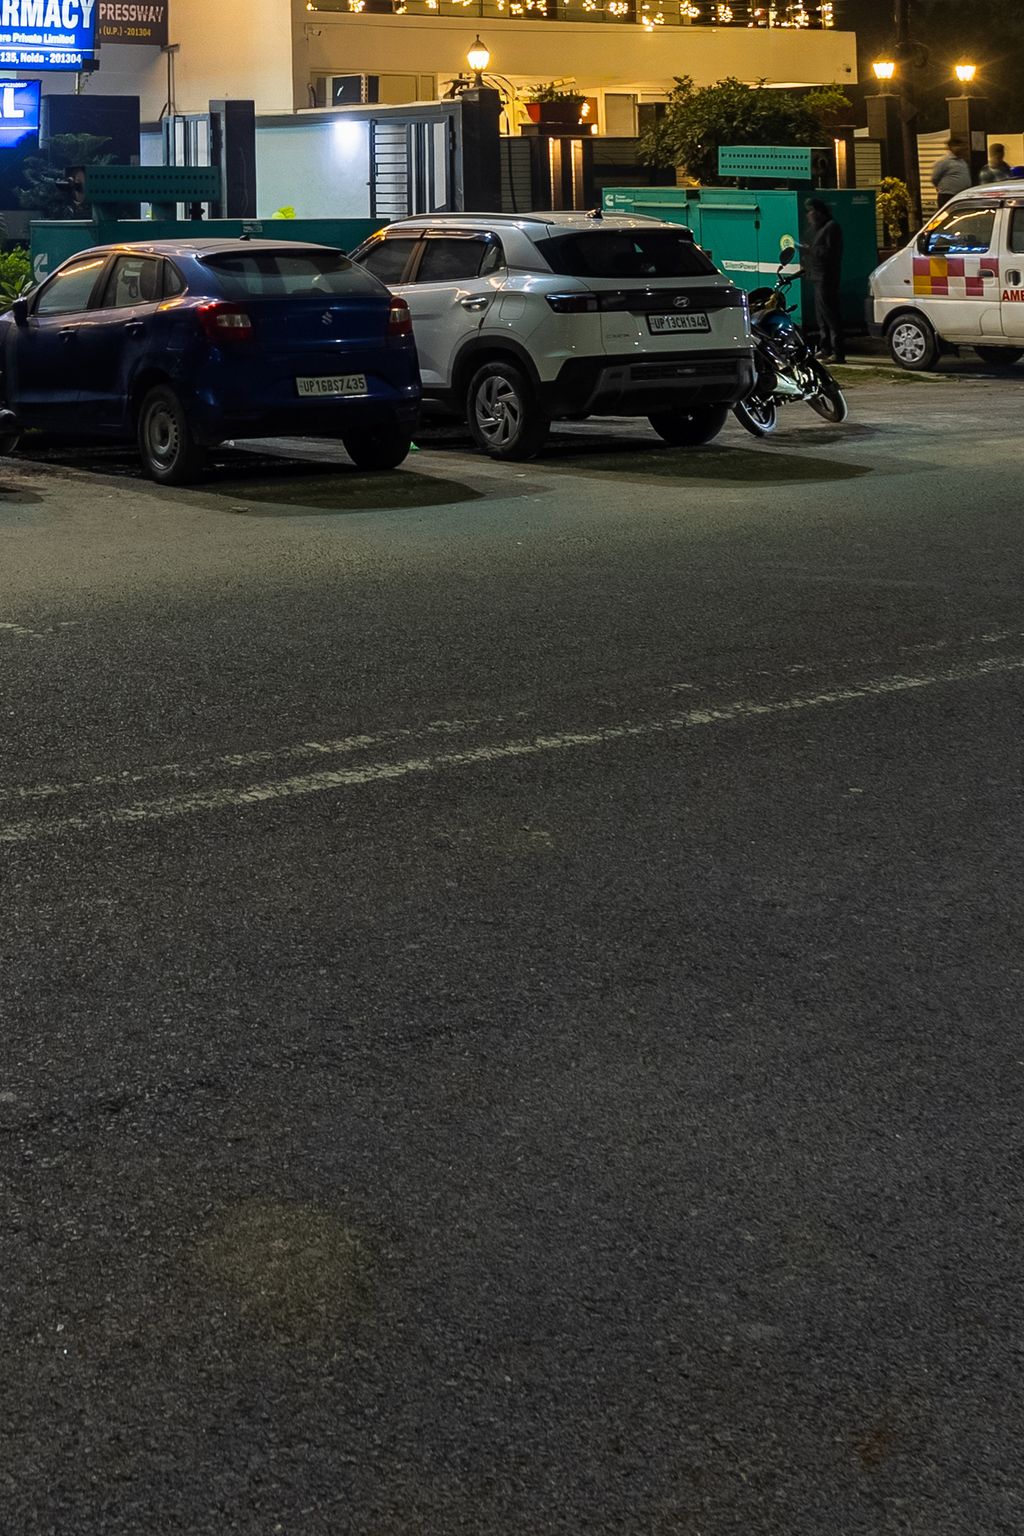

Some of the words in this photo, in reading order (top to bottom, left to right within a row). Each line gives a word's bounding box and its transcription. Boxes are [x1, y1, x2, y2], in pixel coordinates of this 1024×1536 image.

[13, 33, 43, 43] Private
[44, 34, 75, 44] Limited
[20, 52, 44, 63] Noida
[49, 53, 82, 64] 201304
